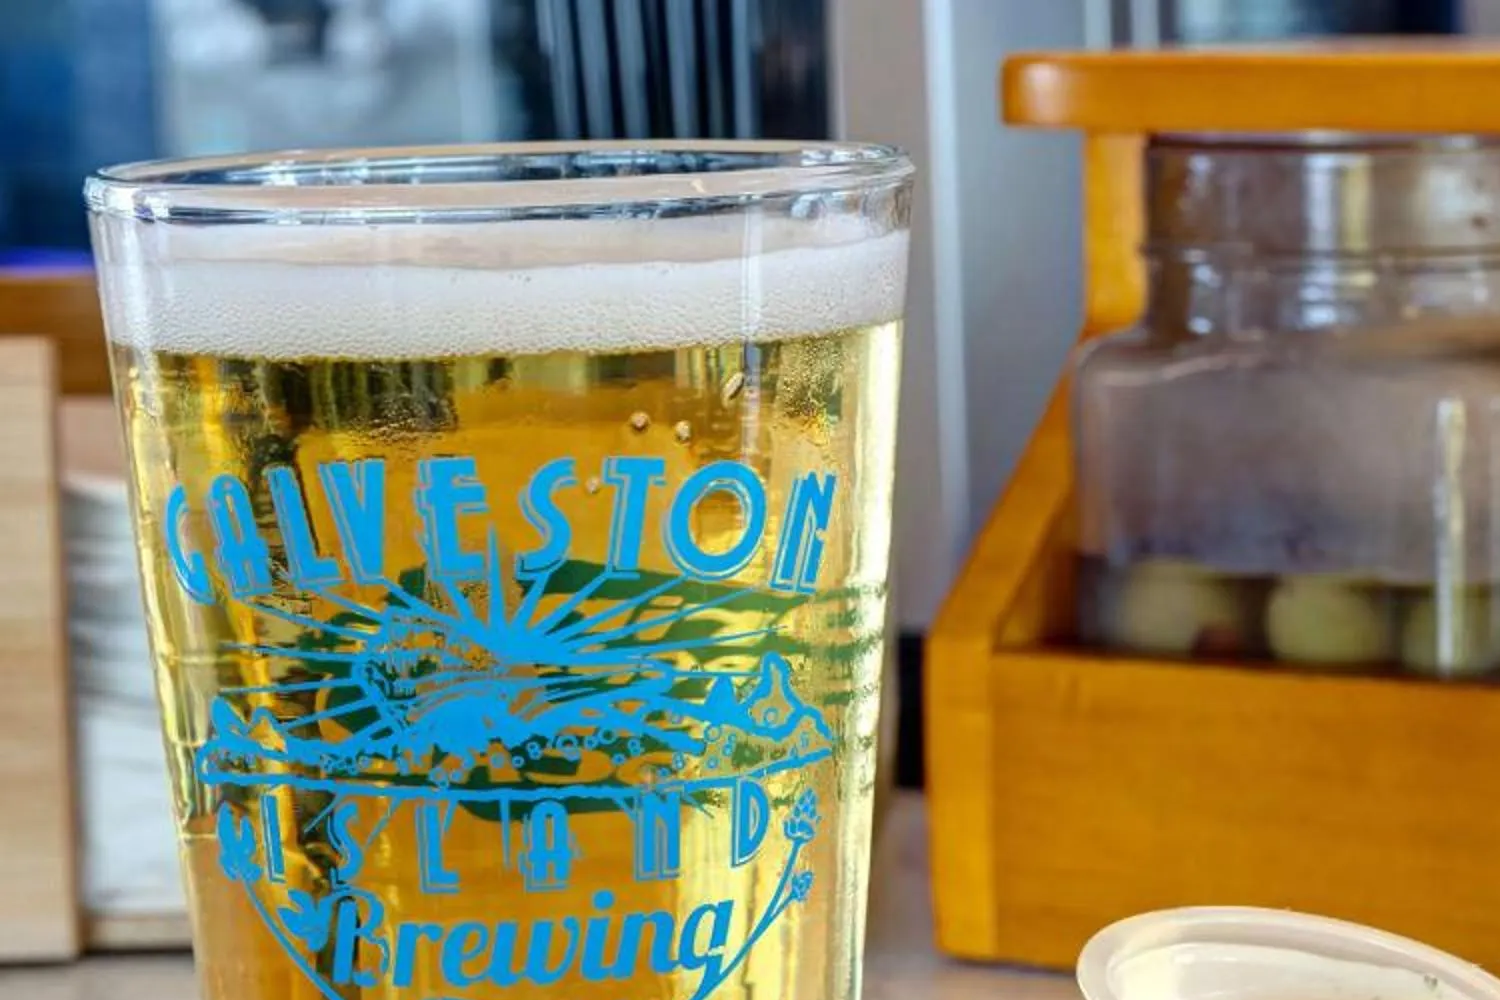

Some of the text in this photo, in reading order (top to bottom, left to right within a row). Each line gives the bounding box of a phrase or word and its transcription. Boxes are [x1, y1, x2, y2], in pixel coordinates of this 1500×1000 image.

[165, 457, 837, 604] GALVESTON
[259, 778, 771, 895] ISLAND
[331, 887, 734, 996] Brewing
